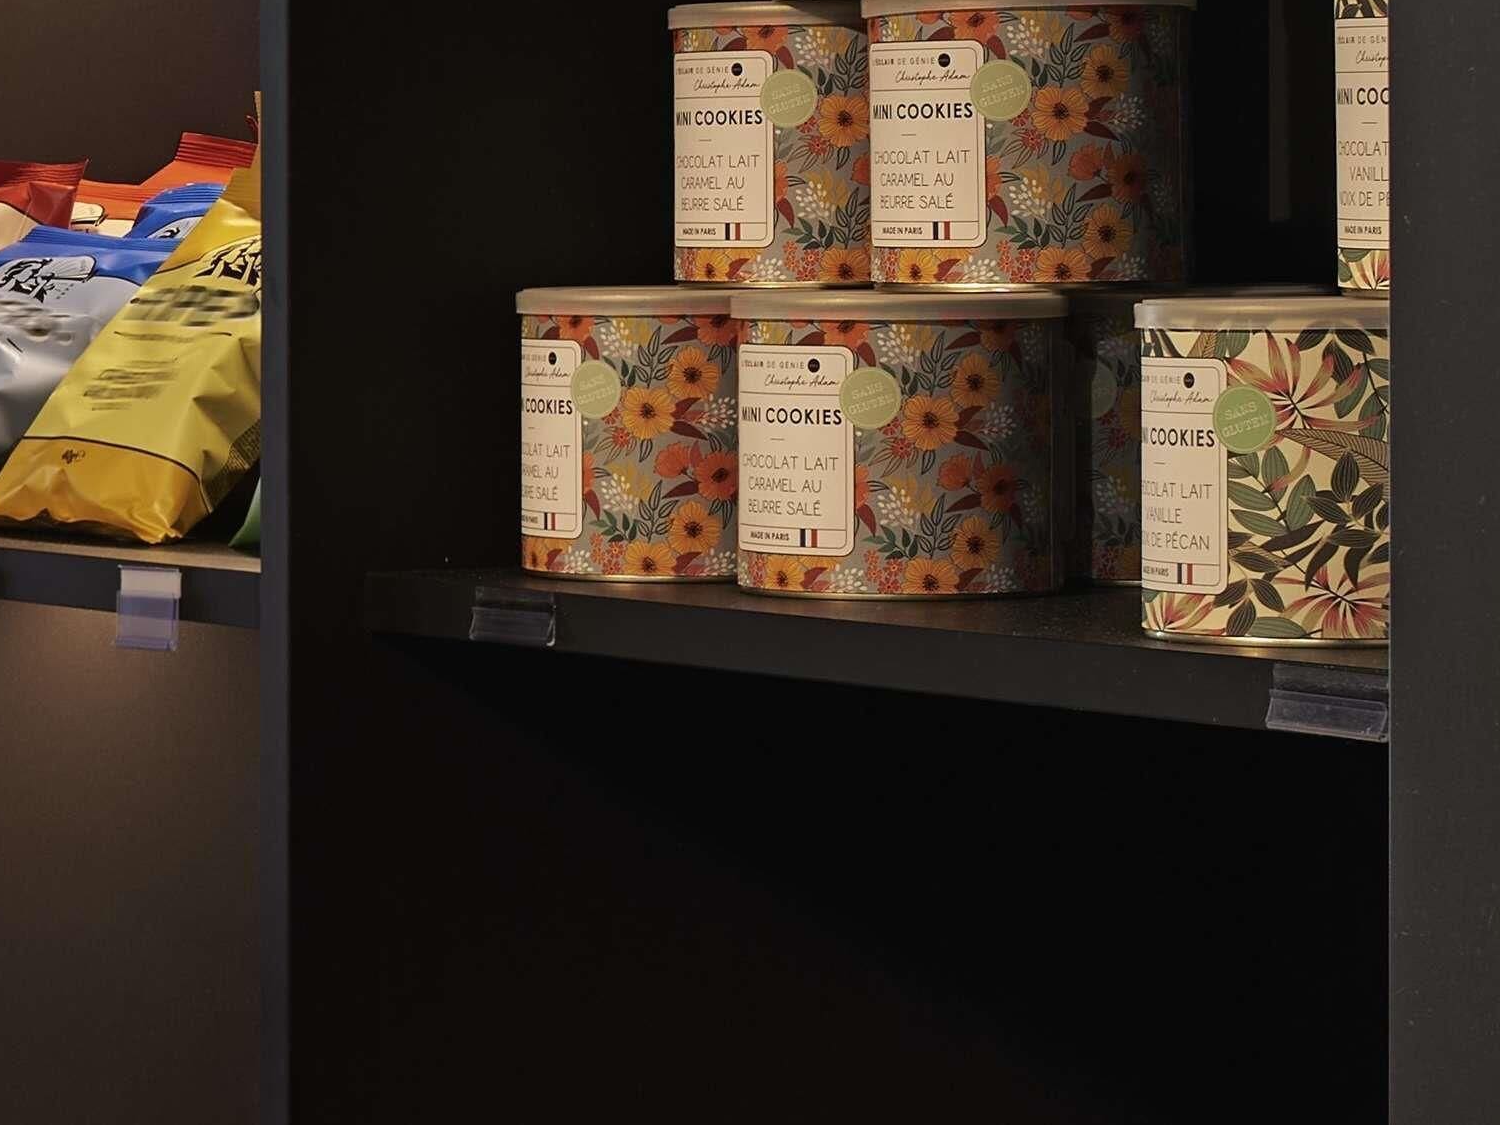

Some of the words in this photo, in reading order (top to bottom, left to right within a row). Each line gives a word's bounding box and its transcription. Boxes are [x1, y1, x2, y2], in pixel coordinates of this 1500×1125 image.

[909, 55, 935, 66] GÉNIE
[707, 65, 729, 74] GÉNIE
[894, 69, 938, 86] Christophe
[939, 69, 971, 82] Adam
[732, 78, 760, 90] Adam
[695, 109, 763, 126] COOKIES
[872, 103, 892, 120] MINI
[896, 102, 974, 120] COOKIES
[728, 154, 760, 168] LAIT
[874, 150, 930, 165] CHOCOLAT
[935, 149, 970, 165] LAIT
[681, 176, 722, 190] CARAMEL
[726, 176, 745, 190] AU
[880, 172, 929, 187] CARAMEL
[933, 172, 954, 187] AU
[681, 197, 710, 211] BEURRE
[713, 195, 745, 211] SALÉ
[880, 195, 916, 209] BEURRE
[919, 192, 955, 209] SALÉ
[1358, 191, 1373, 207] DE
[700, 227, 717, 236] PARIS
[882, 227, 897, 235] MADE
[896, 227, 903, 235] IN
[904, 226, 923, 235] PARIS
[1364, 226, 1382, 235] PARIS
[779, 359, 805, 370] GÉNIE
[764, 373, 807, 390] Christophe
[808, 374, 839, 387] Adam
[525, 397, 573, 415] COOKIES
[1223, 401, 1258, 420] SANS
[741, 406, 761, 423] MINI
[765, 407, 842, 426] COOKIES
[1222, 413, 1270, 437] GLUTEN
[1150, 428, 1216, 448] COOKIES
[546, 444, 571, 458] LAIT
[742, 453, 799, 470] CHOCOLAT
[804, 456, 839, 471] LAIT
[545, 466, 559, 479] AU
[748, 476, 797, 493] CARAMEL
[801, 479, 822, 493] AU
[1180, 483, 1213, 499] LAIT
[535, 485, 558, 501] SALÉ
[748, 499, 782, 515] BEURRE
[786, 499, 822, 516] SALÉ
[750, 531, 764, 539] MADE
[764, 531, 771, 540] IN
[771, 531, 790, 541] PARIS
[1151, 531, 1162, 548] DE
[1165, 531, 1210, 550] PÉCAN
